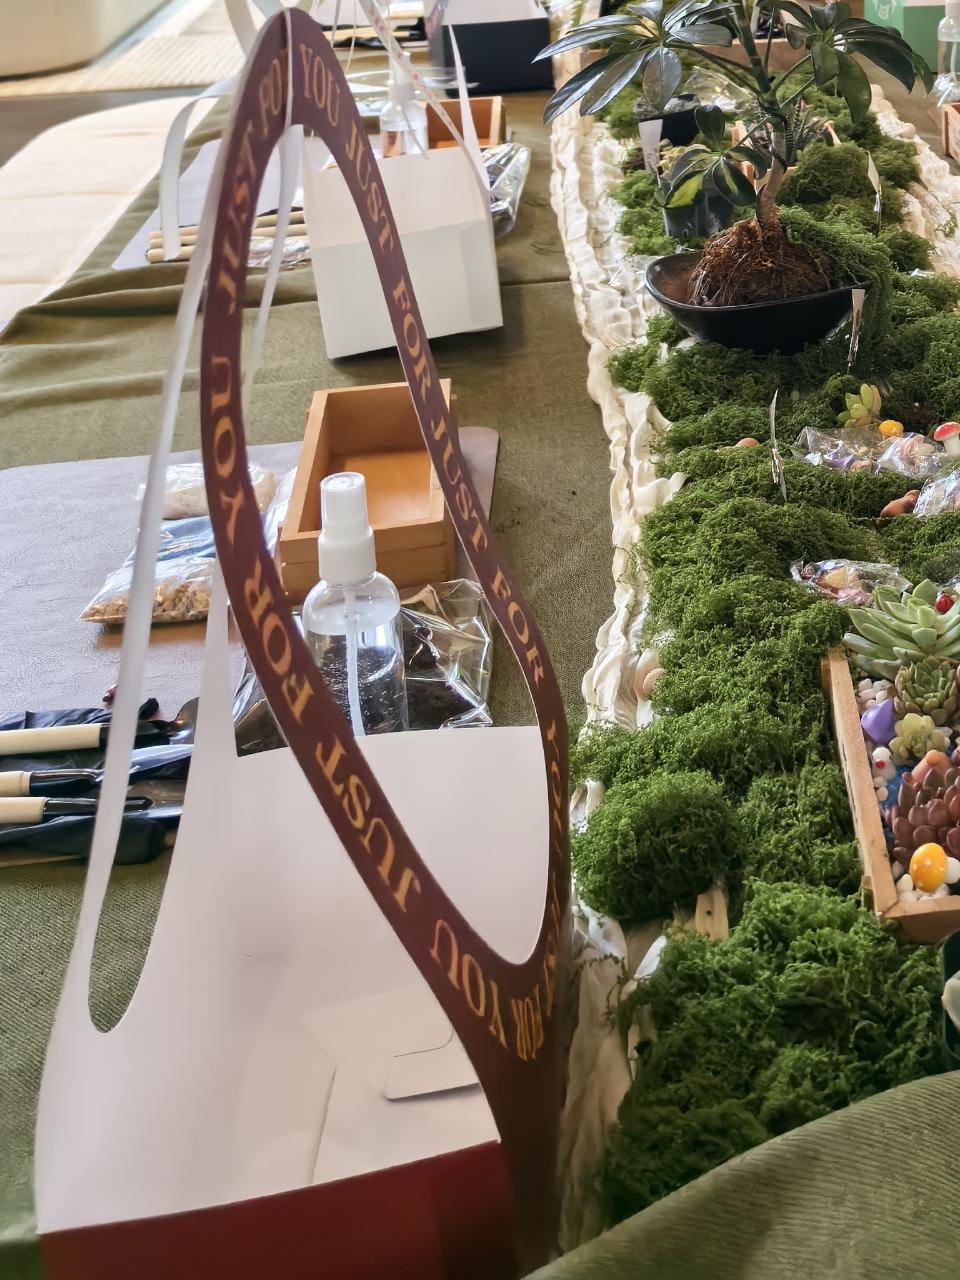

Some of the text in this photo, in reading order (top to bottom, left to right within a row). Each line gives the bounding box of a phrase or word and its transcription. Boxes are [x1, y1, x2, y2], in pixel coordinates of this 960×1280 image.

[300, 44, 341, 127] YOU
[345, 122, 394, 255] JUST
[394, 279, 430, 396] FOR
[211, 355, 239, 546] YOU
[430, 417, 488, 552] JUST
[243, 553, 315, 725] FOR
[490, 564, 545, 689] FOR
[315, 732, 421, 912] JUST
[429, 919, 509, 1051] YOU
